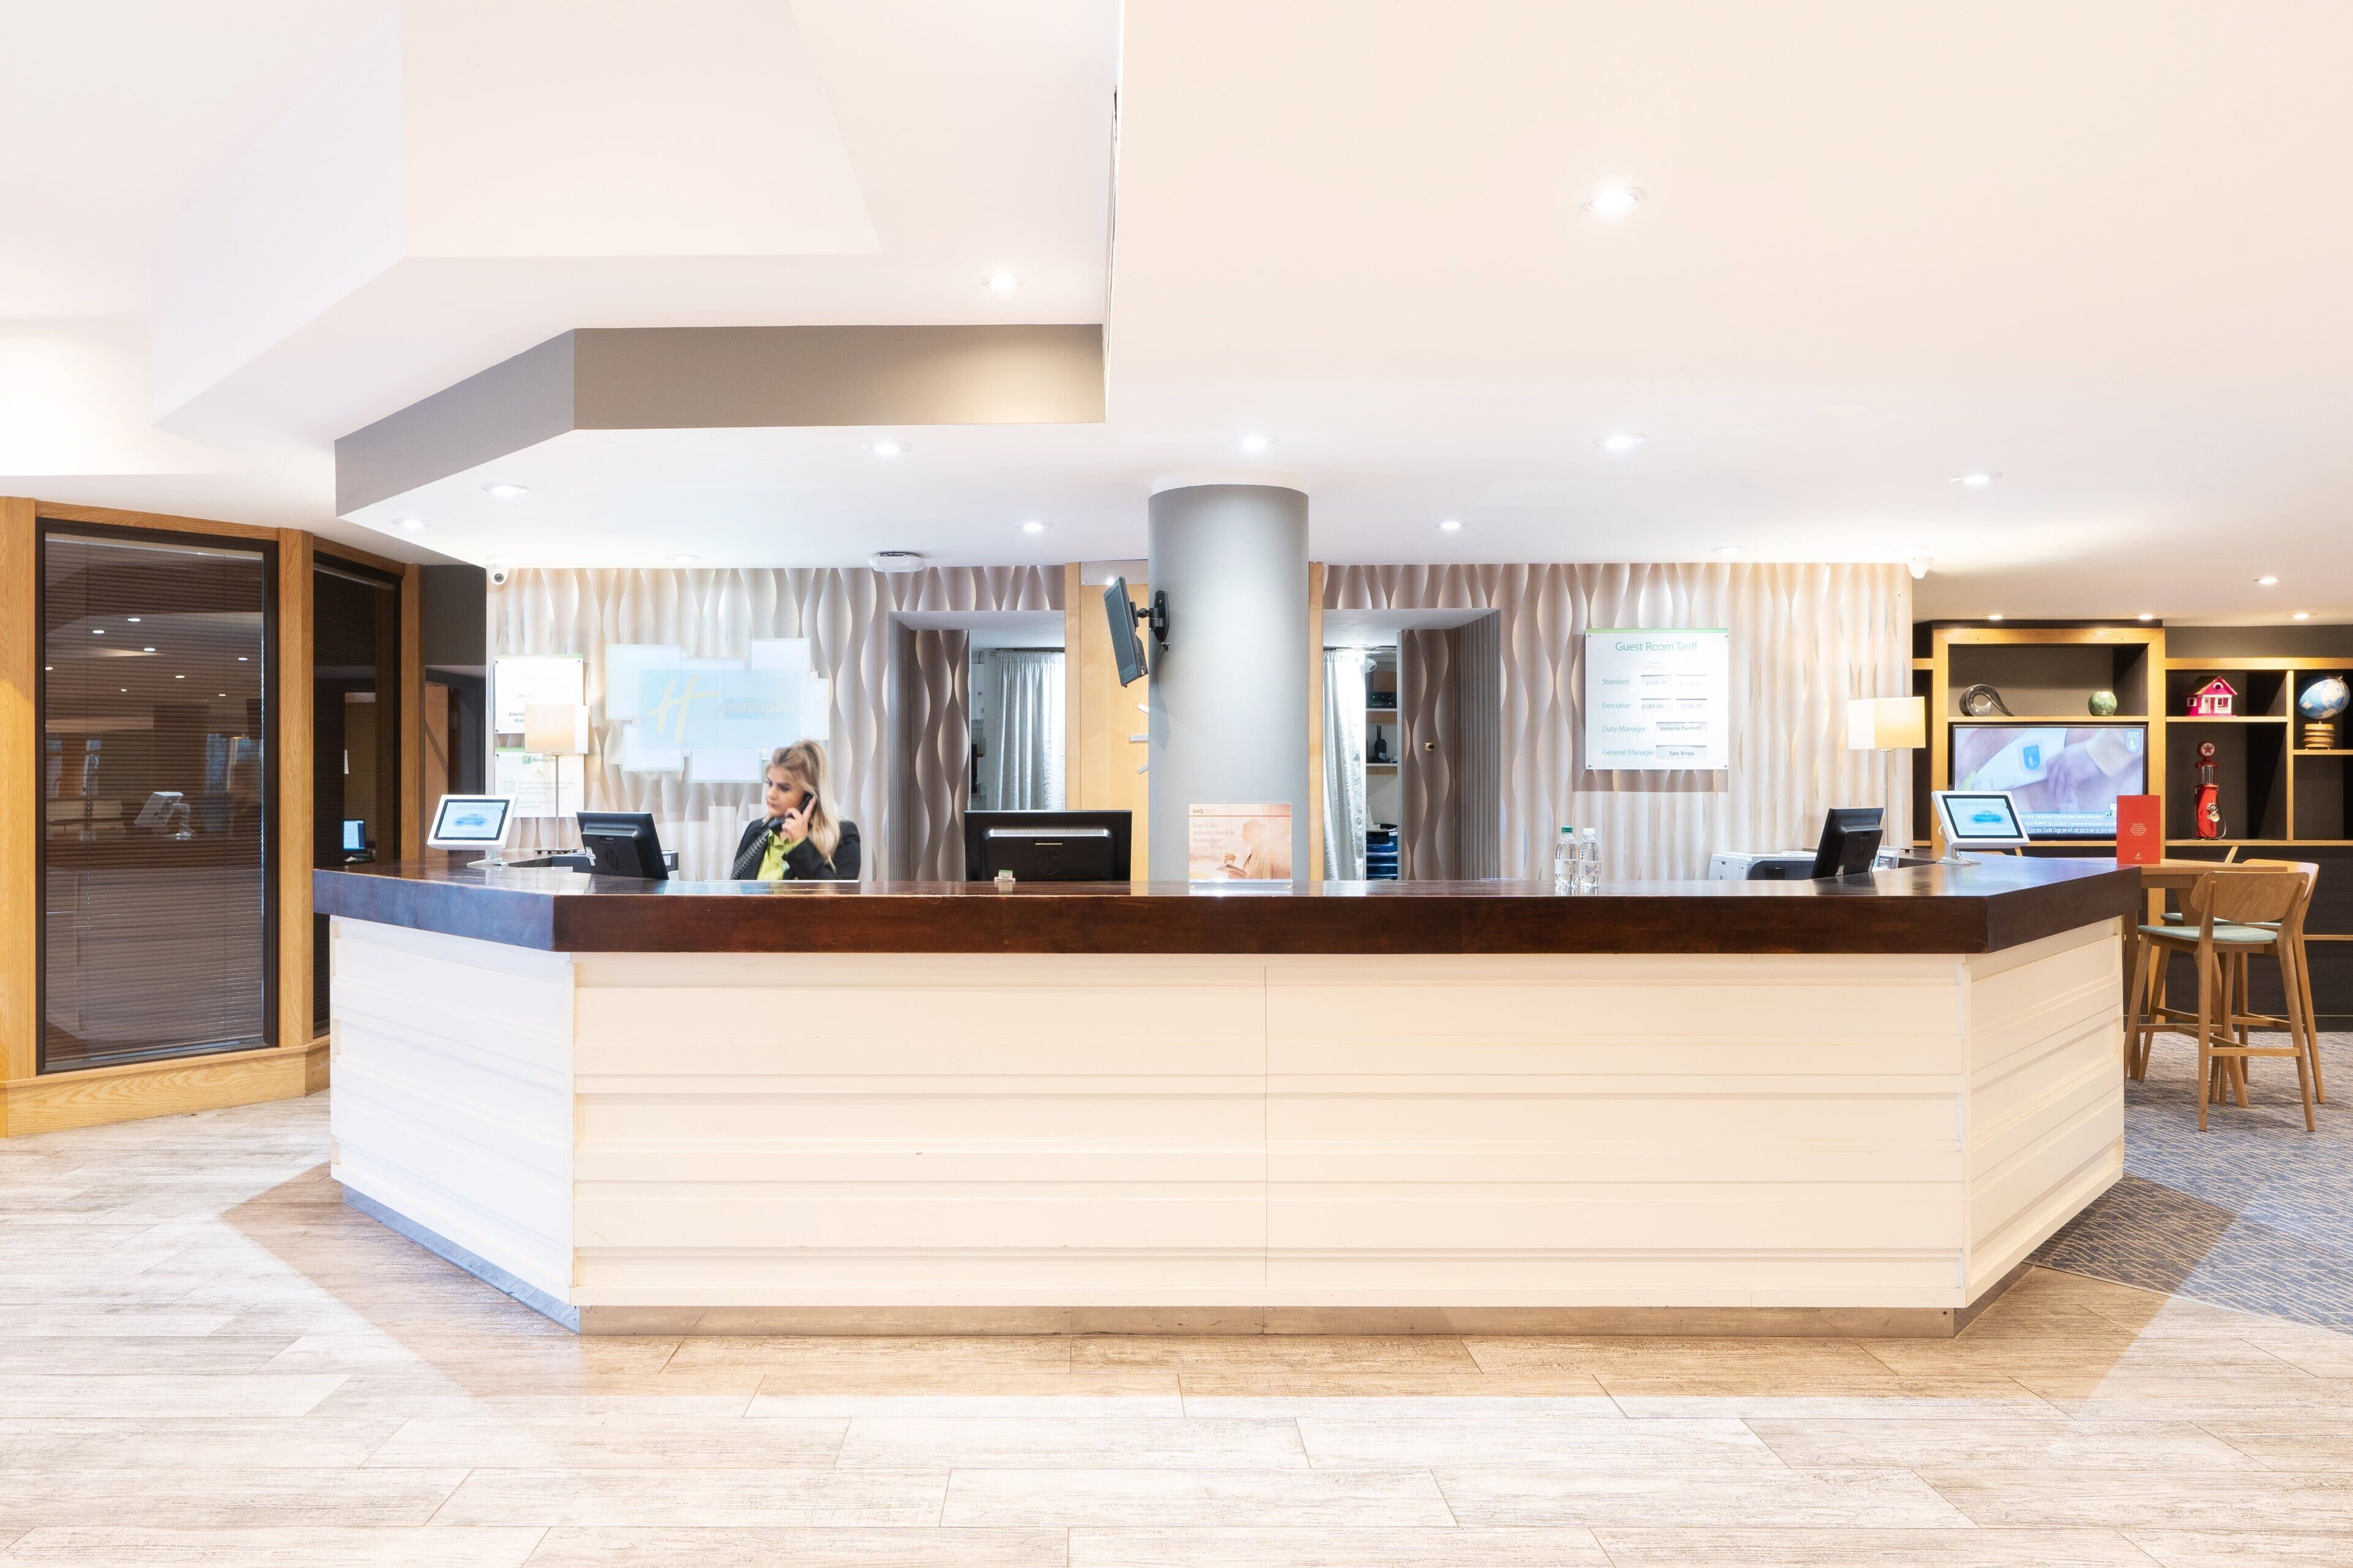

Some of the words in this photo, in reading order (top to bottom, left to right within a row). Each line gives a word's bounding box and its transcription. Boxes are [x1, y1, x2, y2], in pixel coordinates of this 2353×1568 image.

[1615, 642, 1643, 651] Guest
[1645, 642, 1674, 651] Room
[1676, 641, 1699, 651] Tariff
[727, 700, 773, 716] Holiday
[775, 699, 795, 714] Inn
